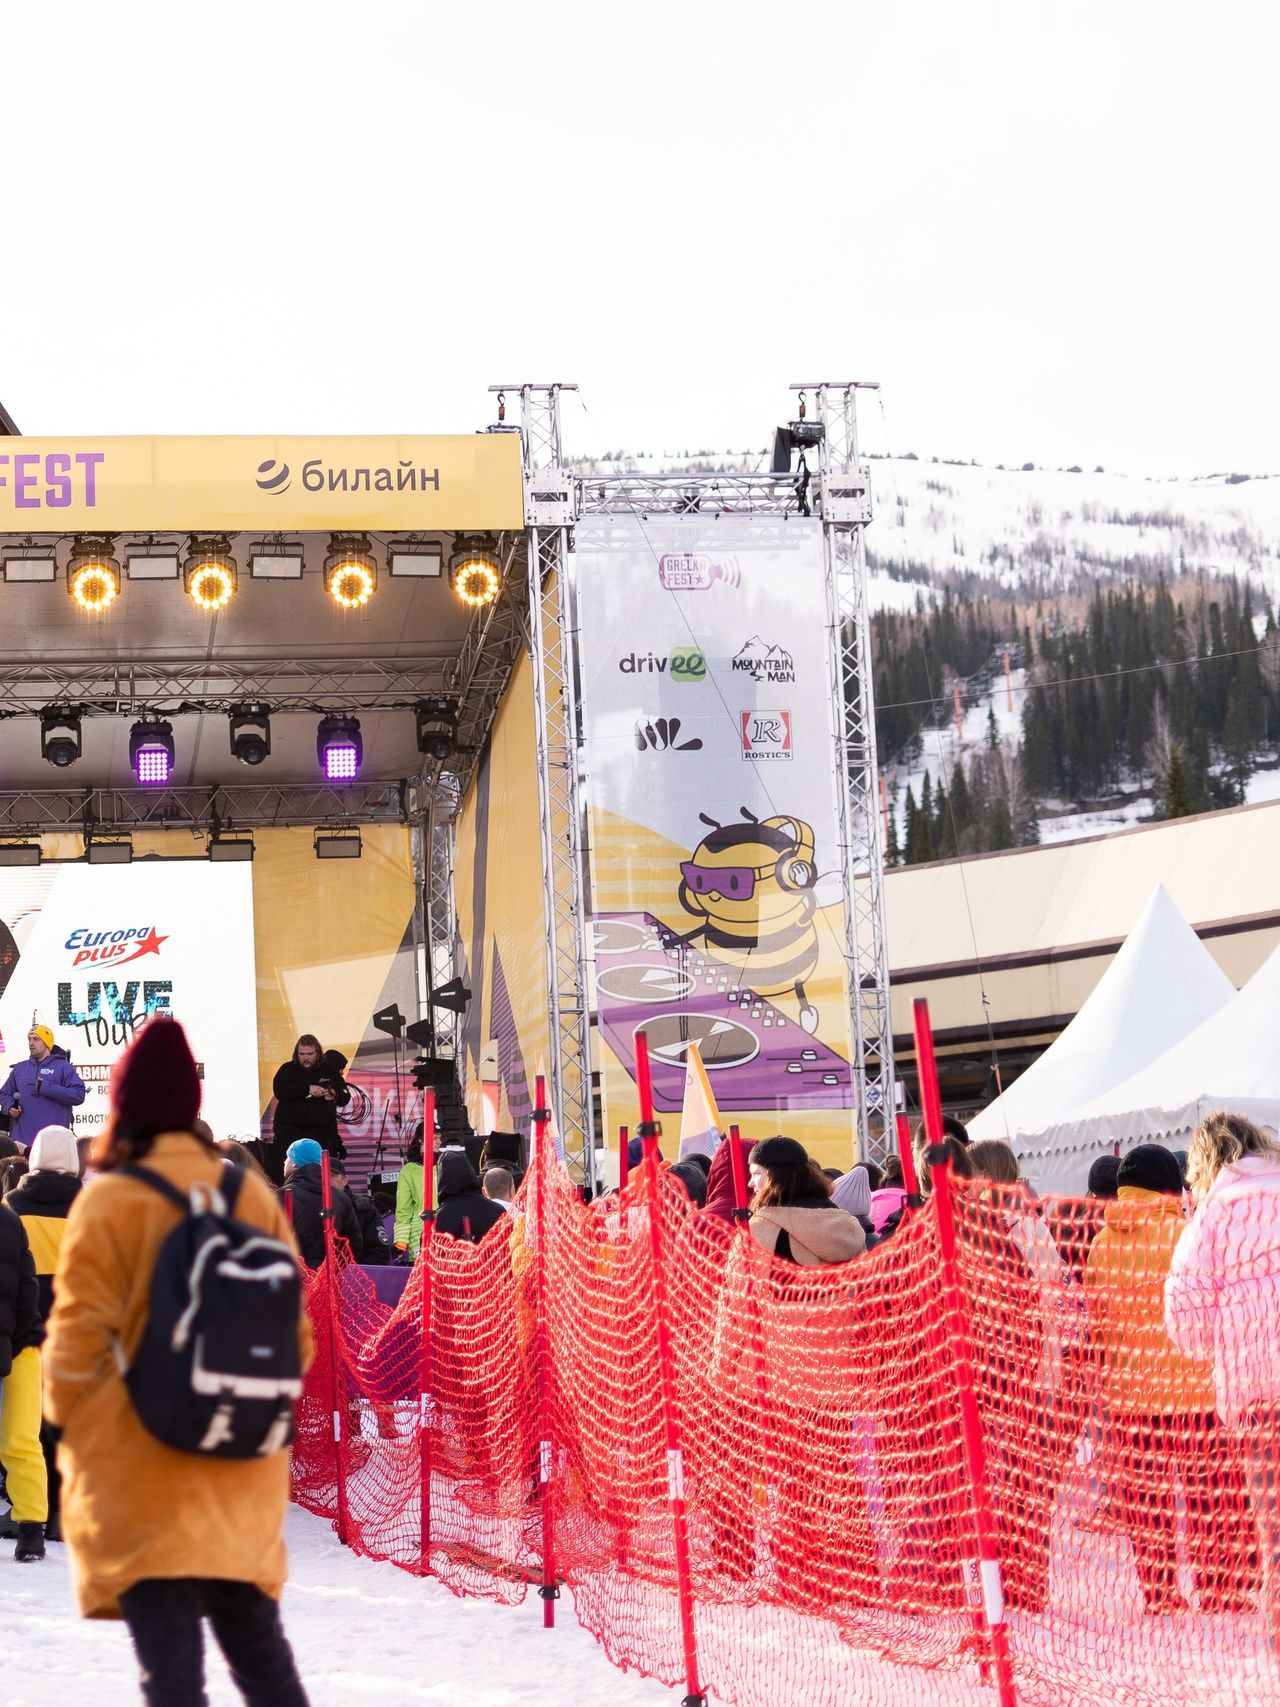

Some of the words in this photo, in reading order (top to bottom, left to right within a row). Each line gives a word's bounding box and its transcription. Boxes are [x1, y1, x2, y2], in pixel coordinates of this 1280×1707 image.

[302, 460, 440, 492] билайн
[667, 559, 706, 572] GRELKA
[668, 573, 693, 585] FEST
[618, 652, 706, 676] drivee
[732, 658, 794, 671] MOUNTAIN
[767, 672, 796, 683] MAN
[744, 751, 791, 760] ROSTIC'S
[64, 926, 151, 950] Europa
[57, 980, 174, 1026] LIVE
